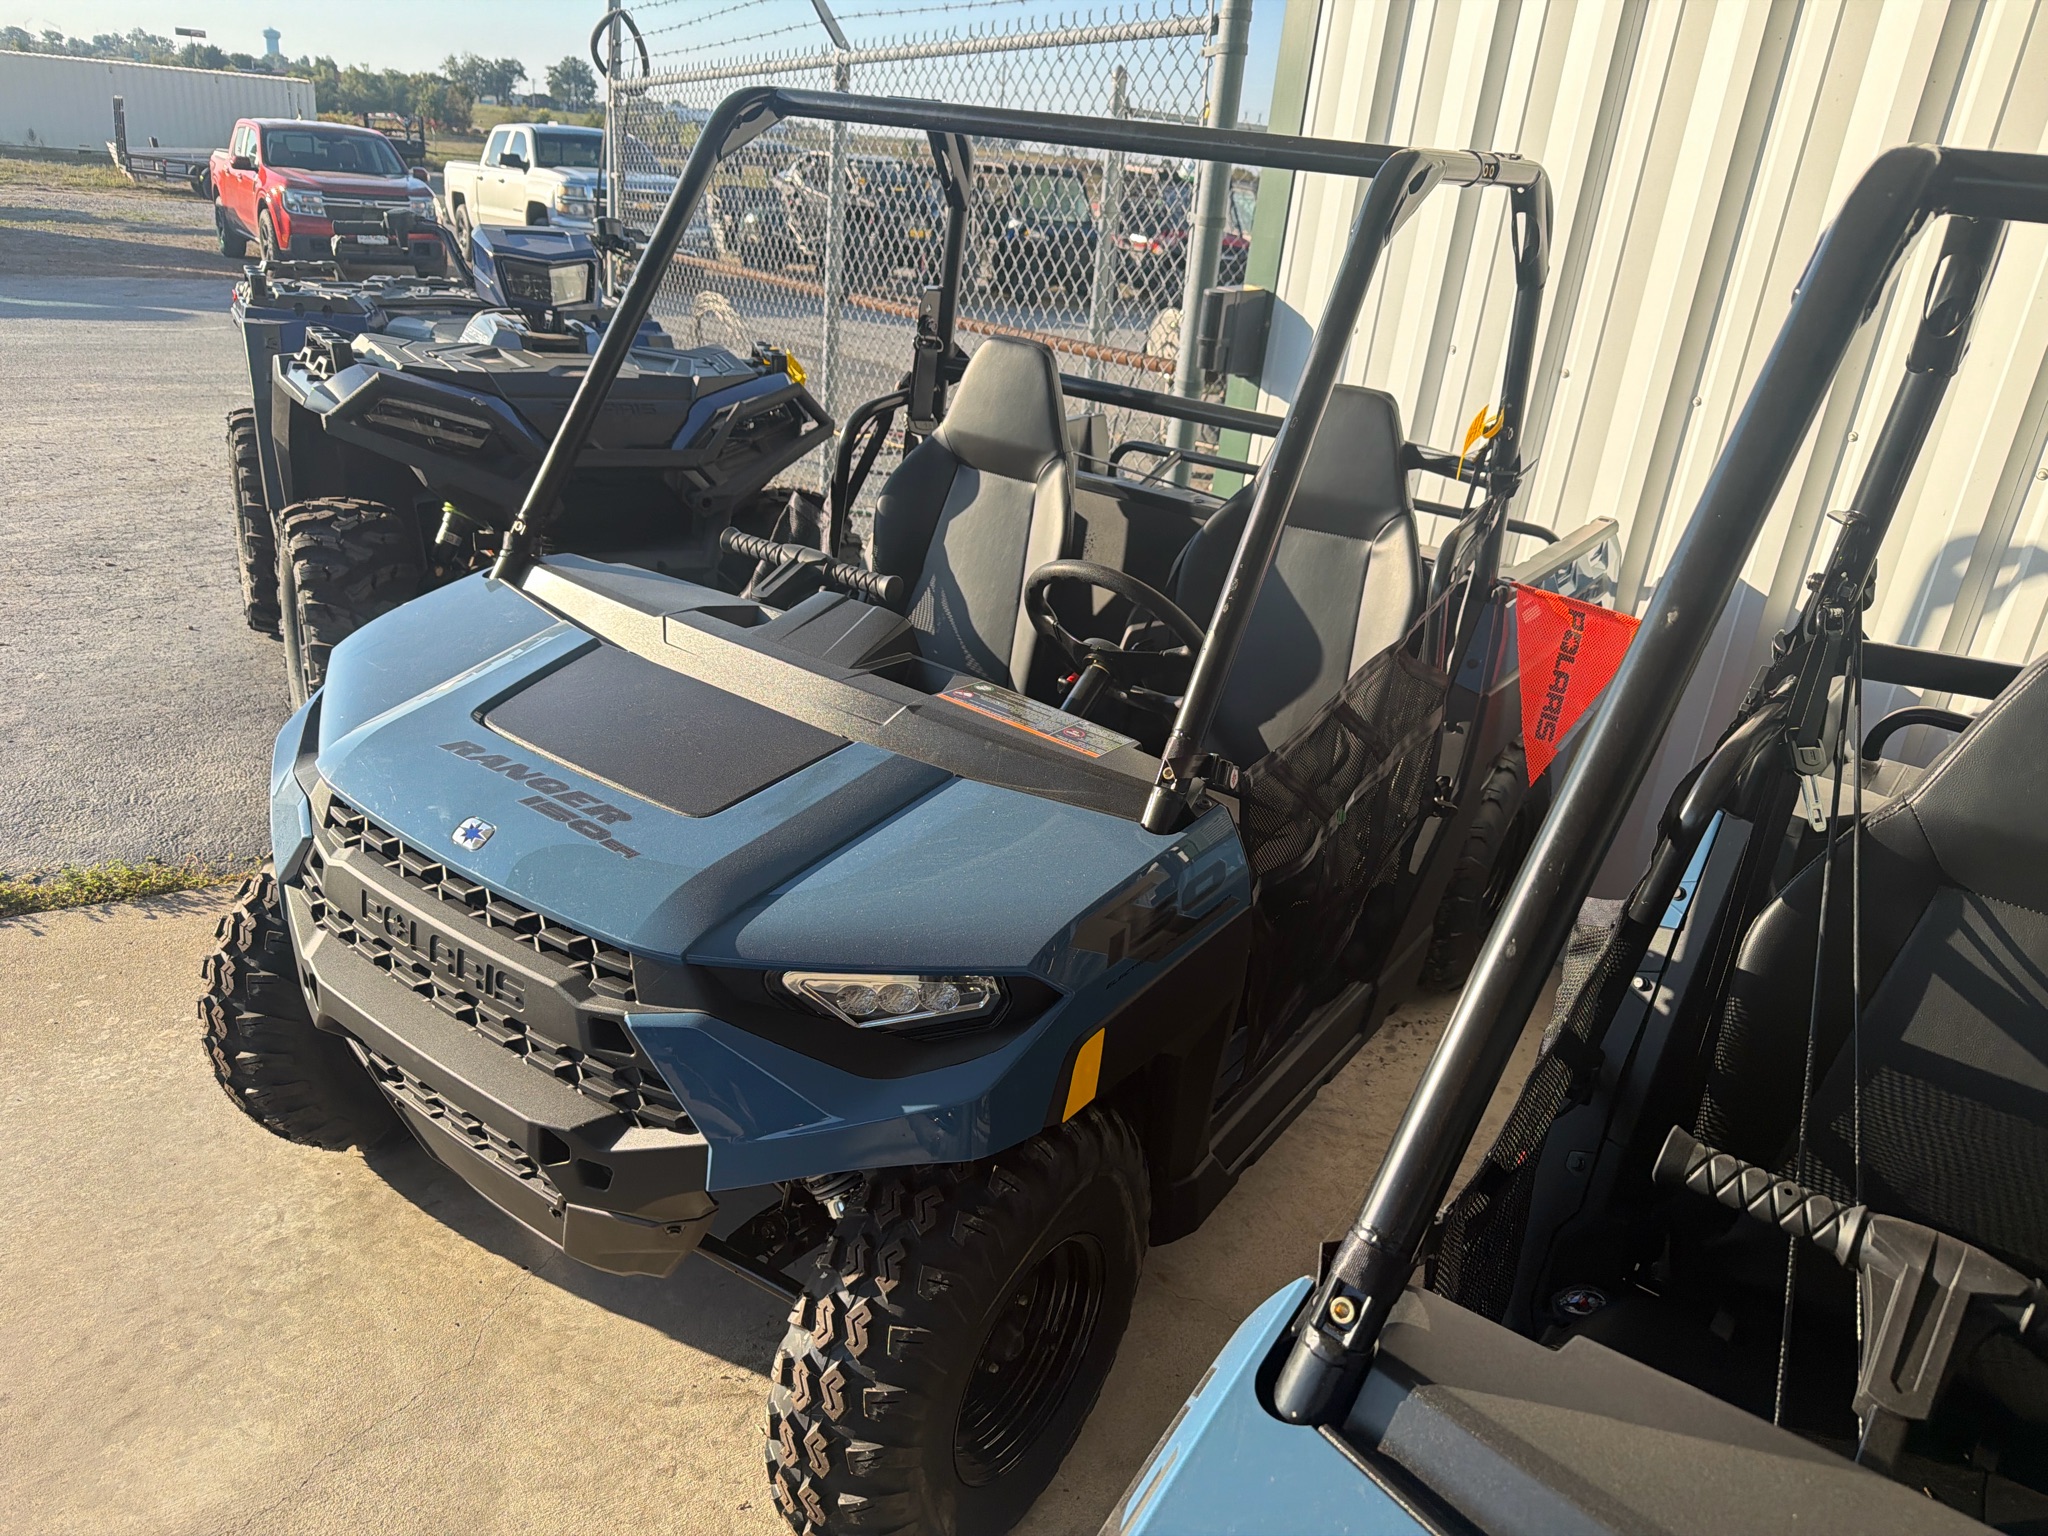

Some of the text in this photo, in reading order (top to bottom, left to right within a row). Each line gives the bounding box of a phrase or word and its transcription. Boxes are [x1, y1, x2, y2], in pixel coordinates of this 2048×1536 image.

[1534, 608, 1586, 742] POLARIS
[436, 740, 632, 825] RANGER
[361, 888, 526, 1013] POLARIS
